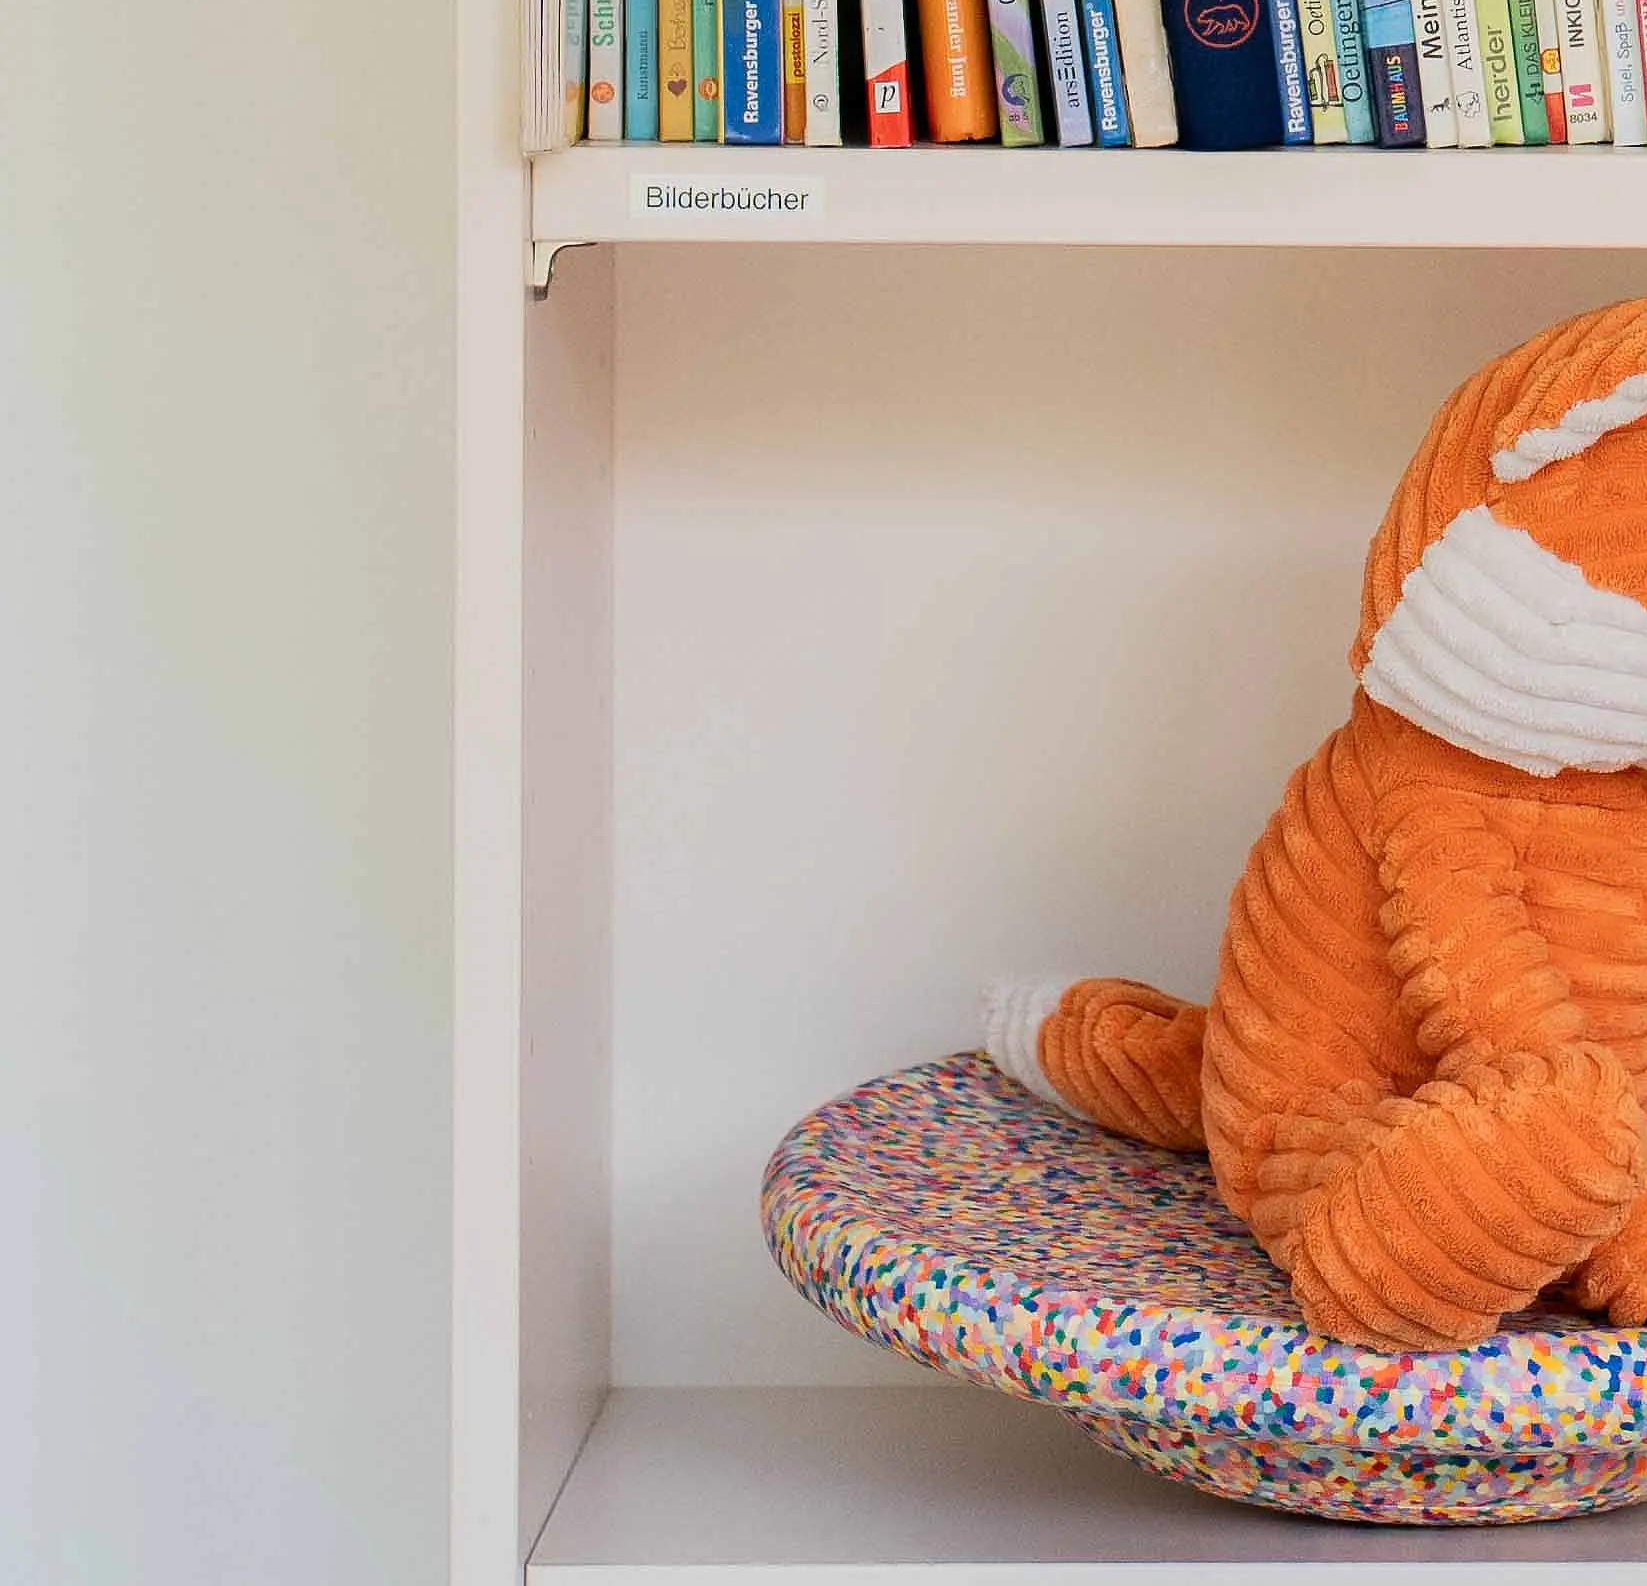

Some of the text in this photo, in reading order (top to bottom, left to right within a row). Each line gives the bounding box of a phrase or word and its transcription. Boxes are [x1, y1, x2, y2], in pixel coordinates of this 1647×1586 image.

[637, 31, 648, 99] Kunstmann
[742, 1, 762, 124] Ravensburger
[789, 12, 804, 78] pestalozzi
[1274, 0, 1307, 133] Ravensburger
[1485, 24, 1513, 122] herder
[1385, 55, 1412, 132] BAUMHAUS
[1568, 113, 1598, 125] 8034
[647, 185, 809, 210] Bilderbücher
